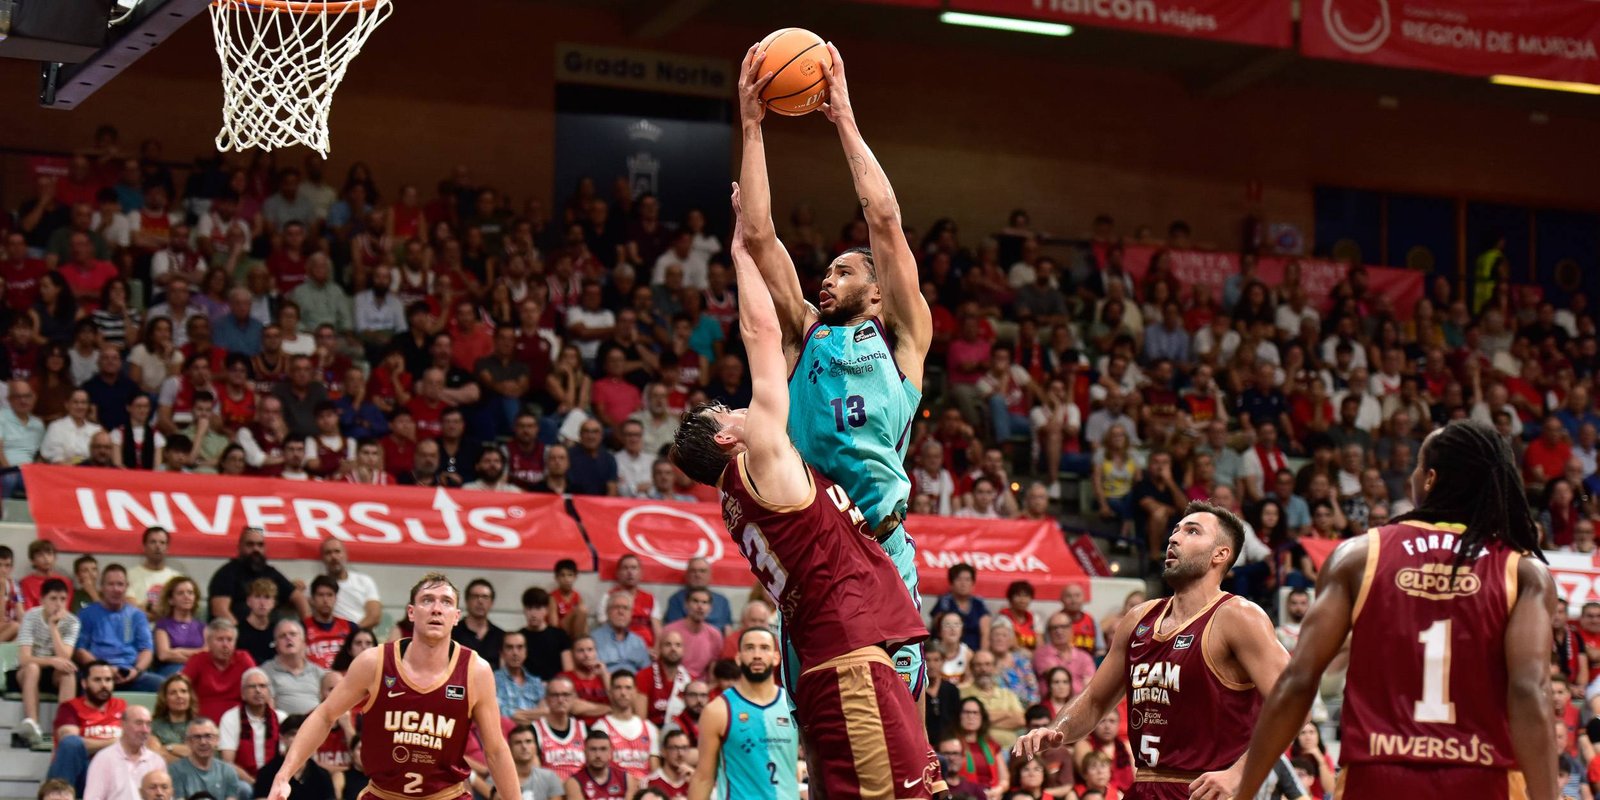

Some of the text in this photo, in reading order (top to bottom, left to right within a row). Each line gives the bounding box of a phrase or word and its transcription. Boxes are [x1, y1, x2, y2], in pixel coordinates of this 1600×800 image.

[1485, 30, 1514, 53] DE
[1517, 34, 1598, 60] MURCIA
[564, 51, 724, 88] Grada Norte
[830, 394, 868, 433] 13
[922, 550, 1049, 573] MURCIA
[1130, 661, 1181, 692] CAM
[1413, 618, 1456, 724] 1
[384, 710, 457, 739] UCAM
[392, 731, 443, 751] MURCIA
[1138, 734, 1161, 768] 5
[403, 772, 424, 794] 2
[766, 761, 779, 785] 2
